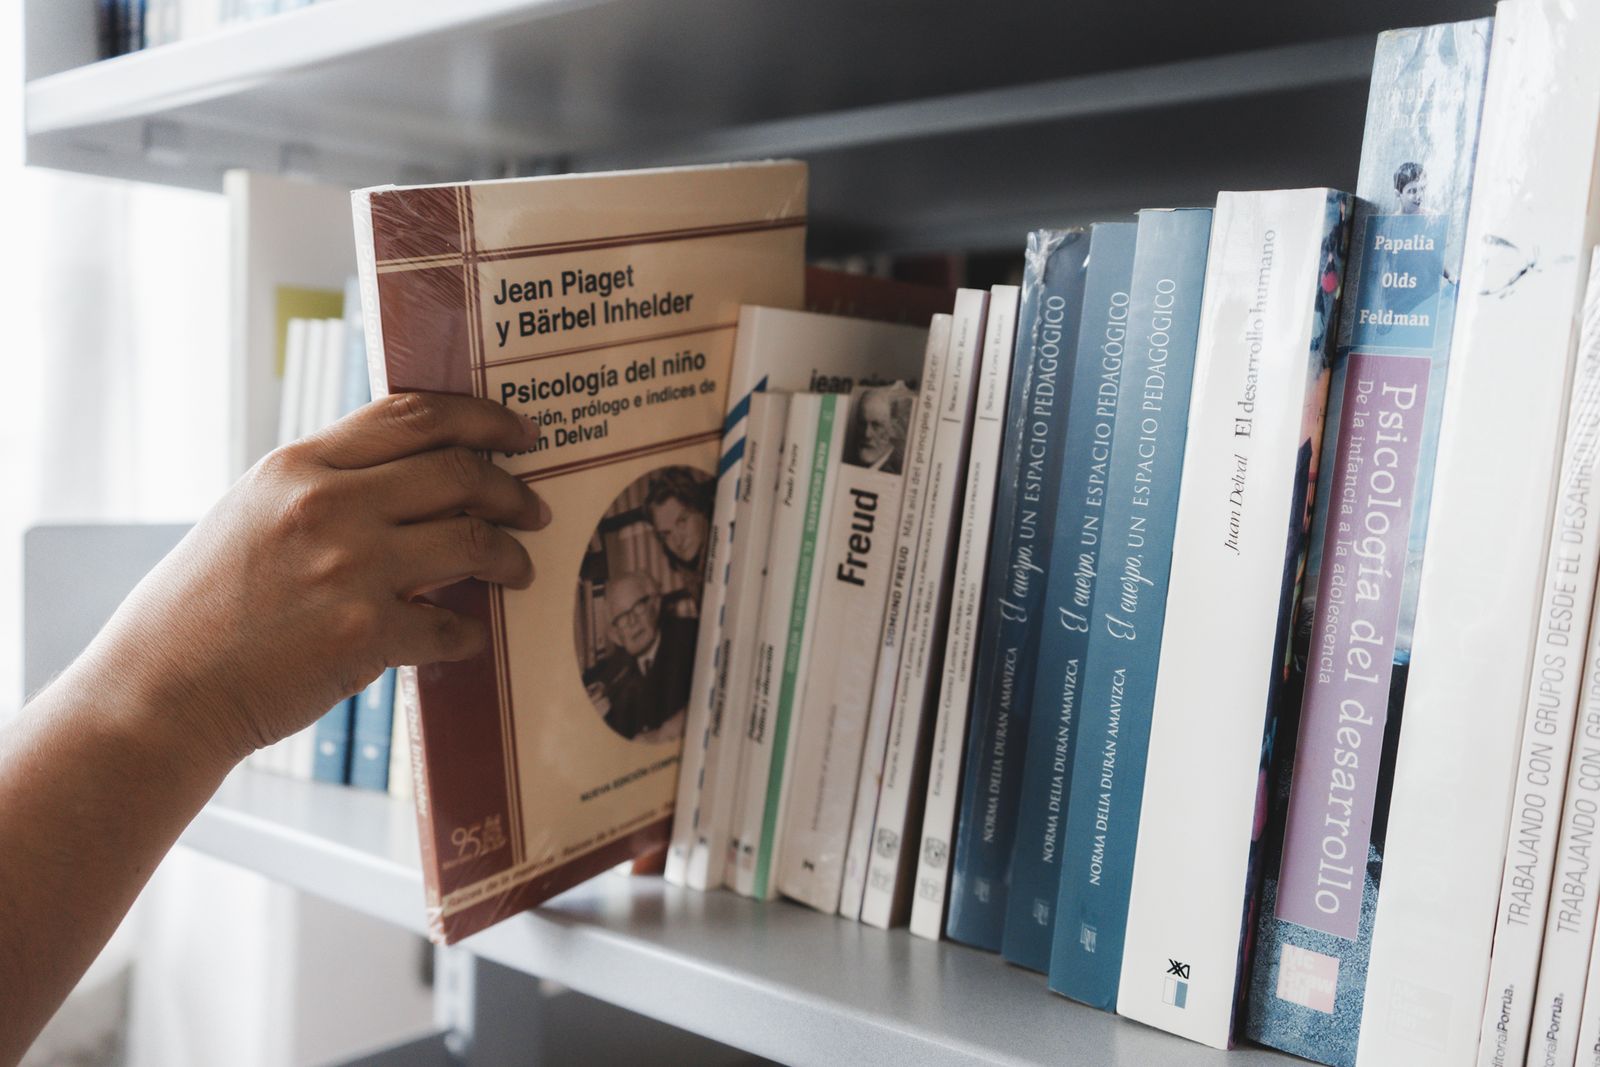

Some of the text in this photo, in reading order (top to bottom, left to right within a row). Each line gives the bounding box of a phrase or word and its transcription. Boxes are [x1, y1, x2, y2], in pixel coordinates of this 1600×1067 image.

[1375, 235, 1434, 253] Papalia
[1382, 272, 1417, 289] Olds
[493, 264, 635, 305] Jean Piaget
[495, 291, 694, 347] y Bärbel Inhelder
[1359, 309, 1430, 327] Feldman
[500, 351, 706, 405] Psicología del niño
[571, 398, 630, 424] prólogo
[633, 395, 643, 408] e
[699, 378, 716, 394] de
[1224, 229, 1276, 556] Juan Delval El desarrollo humano
[1356, 379, 1374, 404] De
[555, 420, 608, 448] Delval
[1353, 411, 1370, 428] la
[895, 546, 909, 589] FREUD
[927, 355, 939, 391] placer
[998, 295, 1066, 623] El cuerpo, UN ESPACIO PEDAGÓGICO
[1058, 291, 1130, 633] El cuerpo, UN ESPACIO PEDAGÓGICO
[1105, 279, 1176, 641] El cuerpo, UN ESPACIO PEDAGÓGICO
[1341, 436, 1366, 514] infancia
[836, 488, 879, 587] Freud
[1336, 541, 1353, 557] la
[1556, 554, 1581, 575] EL
[1315, 382, 1417, 915] Psicología del desarrollo
[1319, 563, 1348, 684] adolescencia
[1546, 584, 1577, 647] DESDE
[1534, 654, 1567, 736] GRUPOS
[984, 647, 1018, 842] NORMA DELIA DURÁN AMAVIZCA
[1043, 659, 1079, 863] NORMA DELIA DURÁN AMAVIZCA
[1089, 669, 1127, 886] NORMA DELIA DURÁN AMAVIZCA
[1527, 743, 1554, 786] CON
[1507, 793, 1546, 927] TRABAJANDO
[1557, 799, 1598, 934] TRABAJANDO
[1578, 747, 1600, 793] CON
